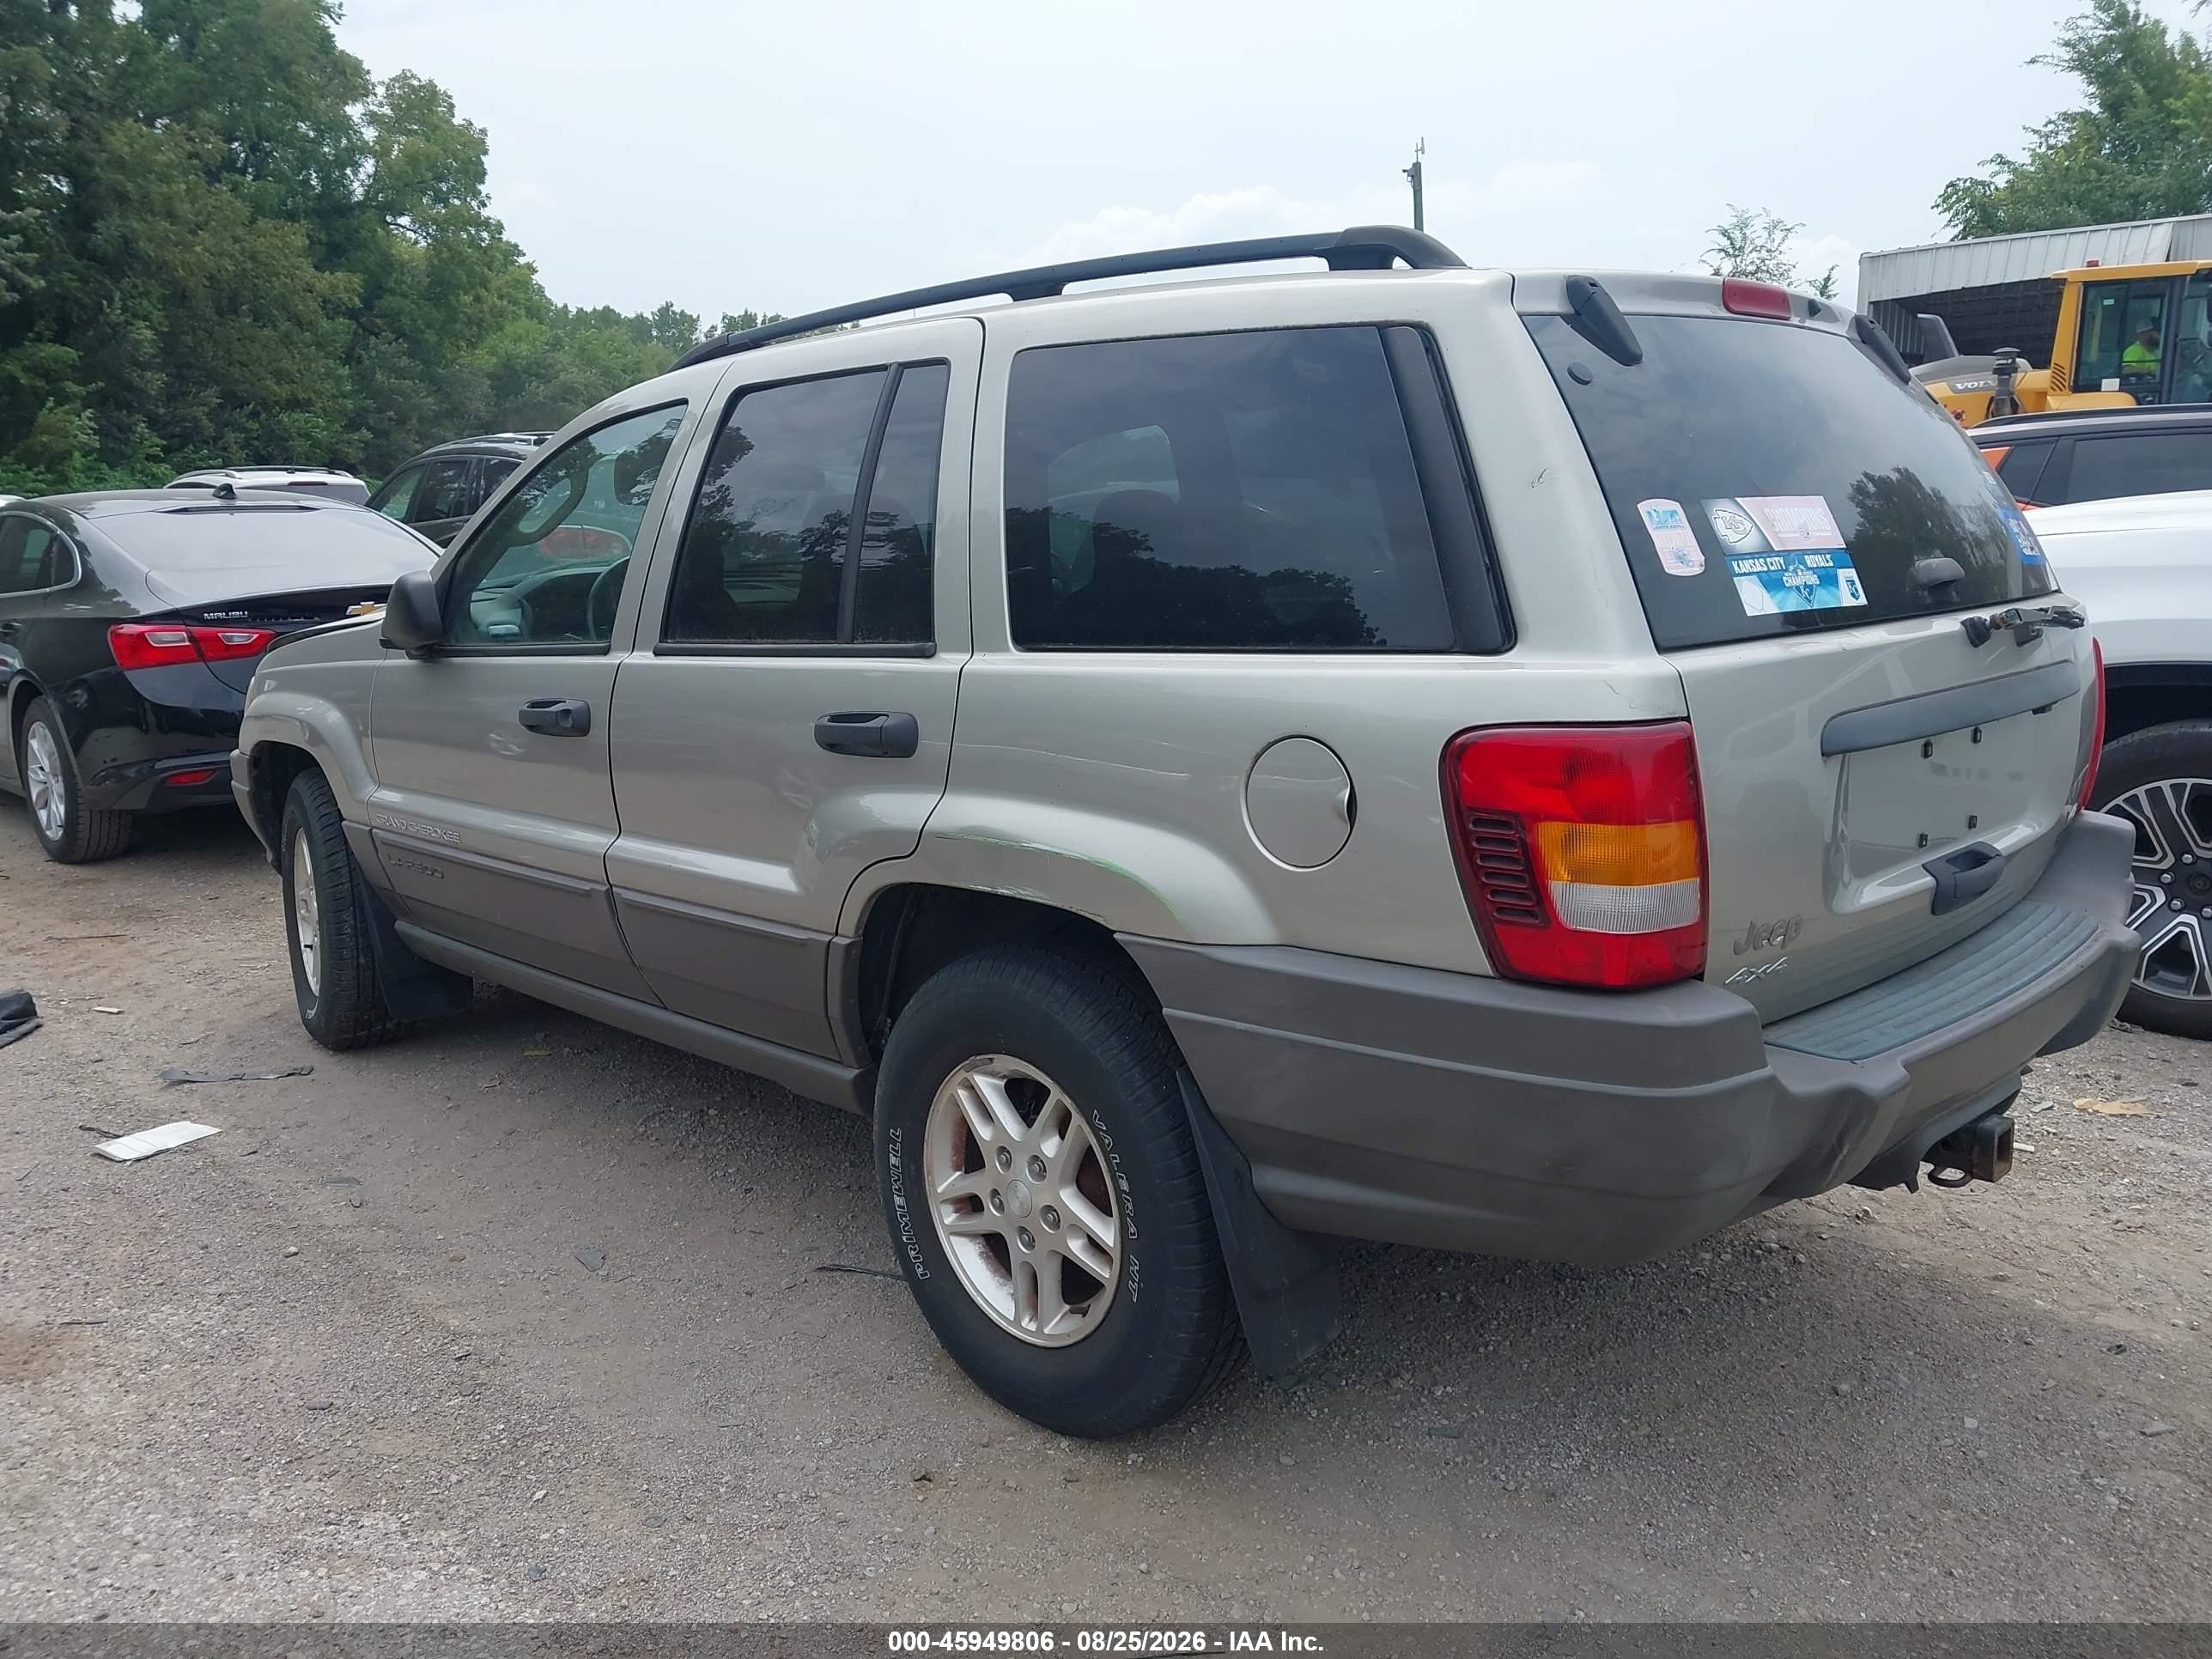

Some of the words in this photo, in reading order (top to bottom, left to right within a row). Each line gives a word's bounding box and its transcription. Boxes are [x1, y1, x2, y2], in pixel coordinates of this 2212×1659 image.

[1731, 558, 1768, 574] KANSAS
[1766, 556, 1786, 571] CITY
[1804, 554, 1834, 568] ROYALS
[1783, 574, 1820, 587] CHAMPIONS
[203, 611, 248, 620] MALIBU
[376, 813, 408, 831] GRAND
[408, 821, 462, 843] CHEROKEE
[1733, 915, 1802, 956] Jeep
[889, 1127, 931, 1279] PRIMEWELL
[1092, 1109, 1138, 1239] VALERA
[1127, 1254, 1140, 1303] HT
